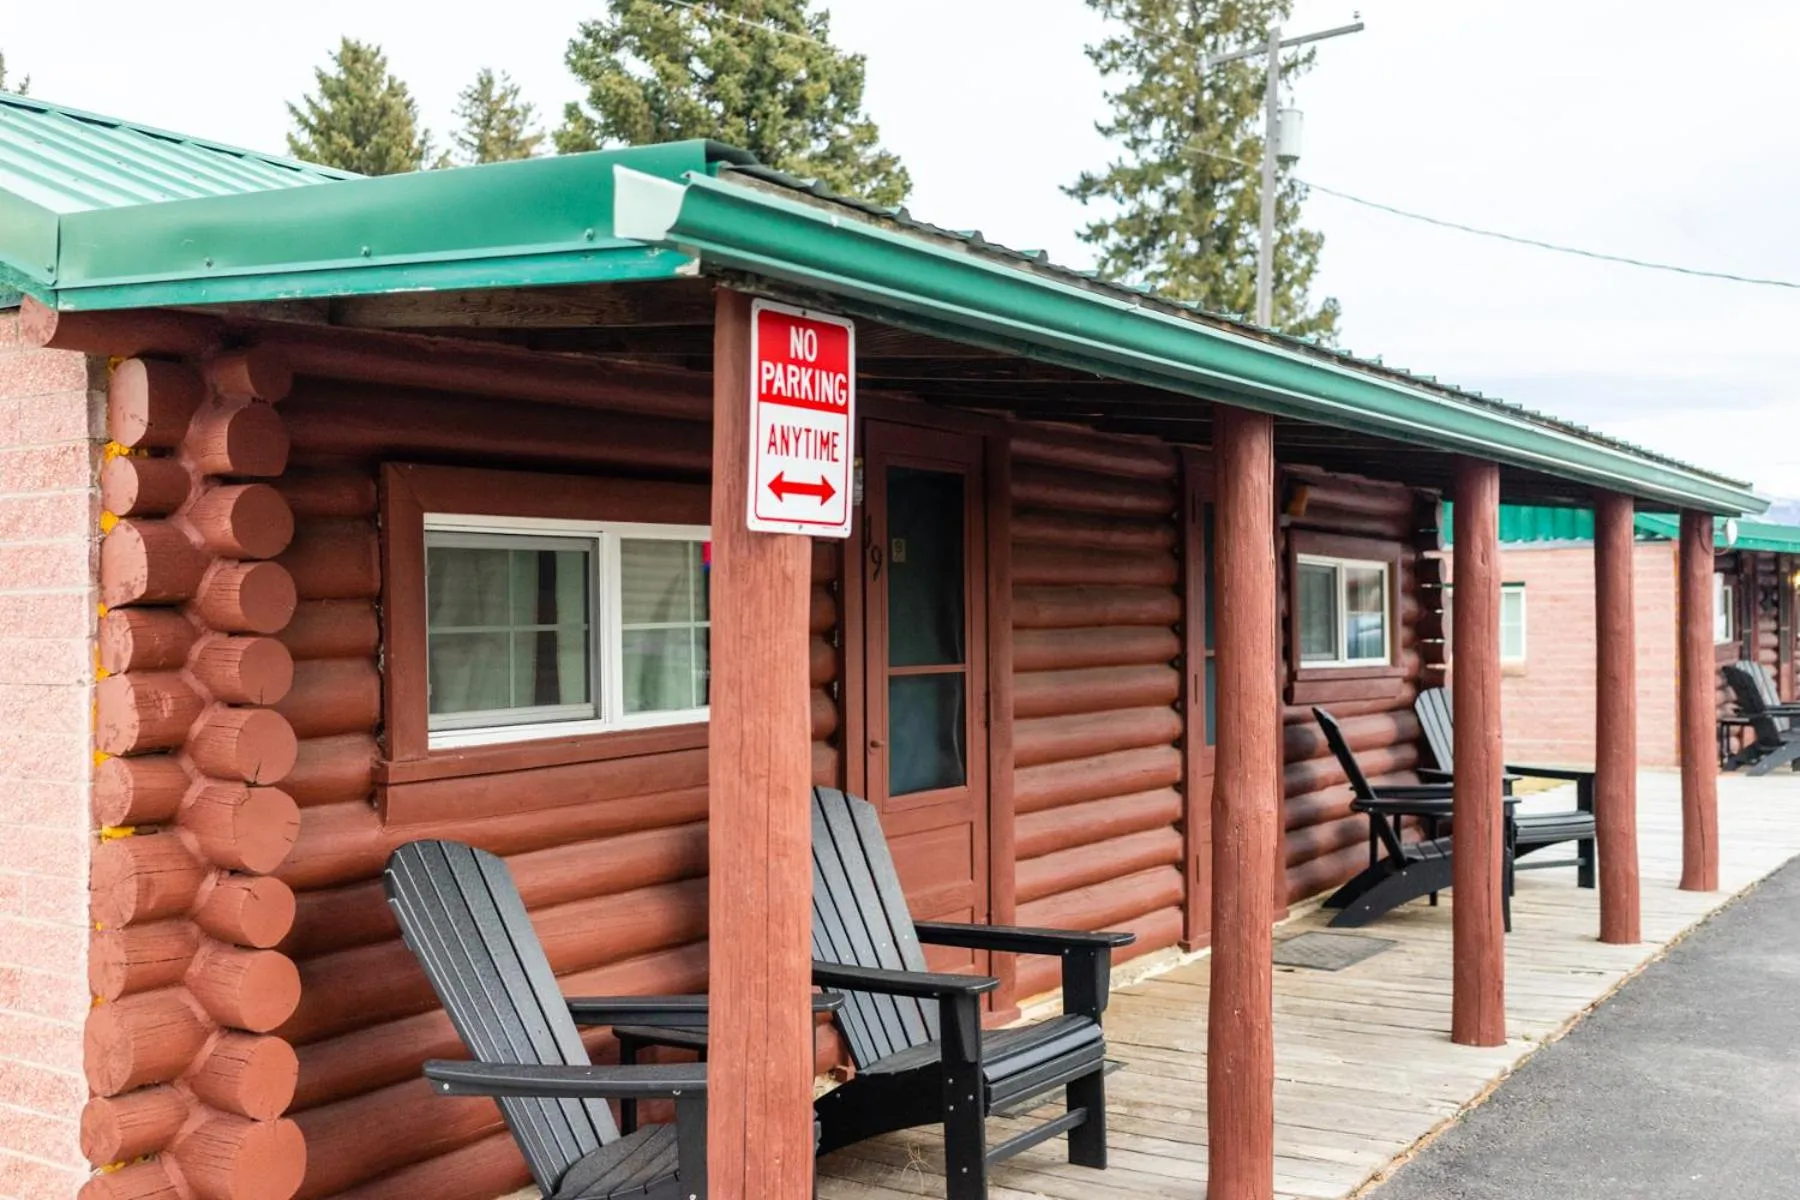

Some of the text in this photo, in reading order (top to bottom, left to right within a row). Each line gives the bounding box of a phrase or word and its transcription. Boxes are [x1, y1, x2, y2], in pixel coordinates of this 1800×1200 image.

[789, 325, 818, 363] NO
[761, 360, 847, 406] PARKING
[767, 423, 839, 463] ANYTIME
